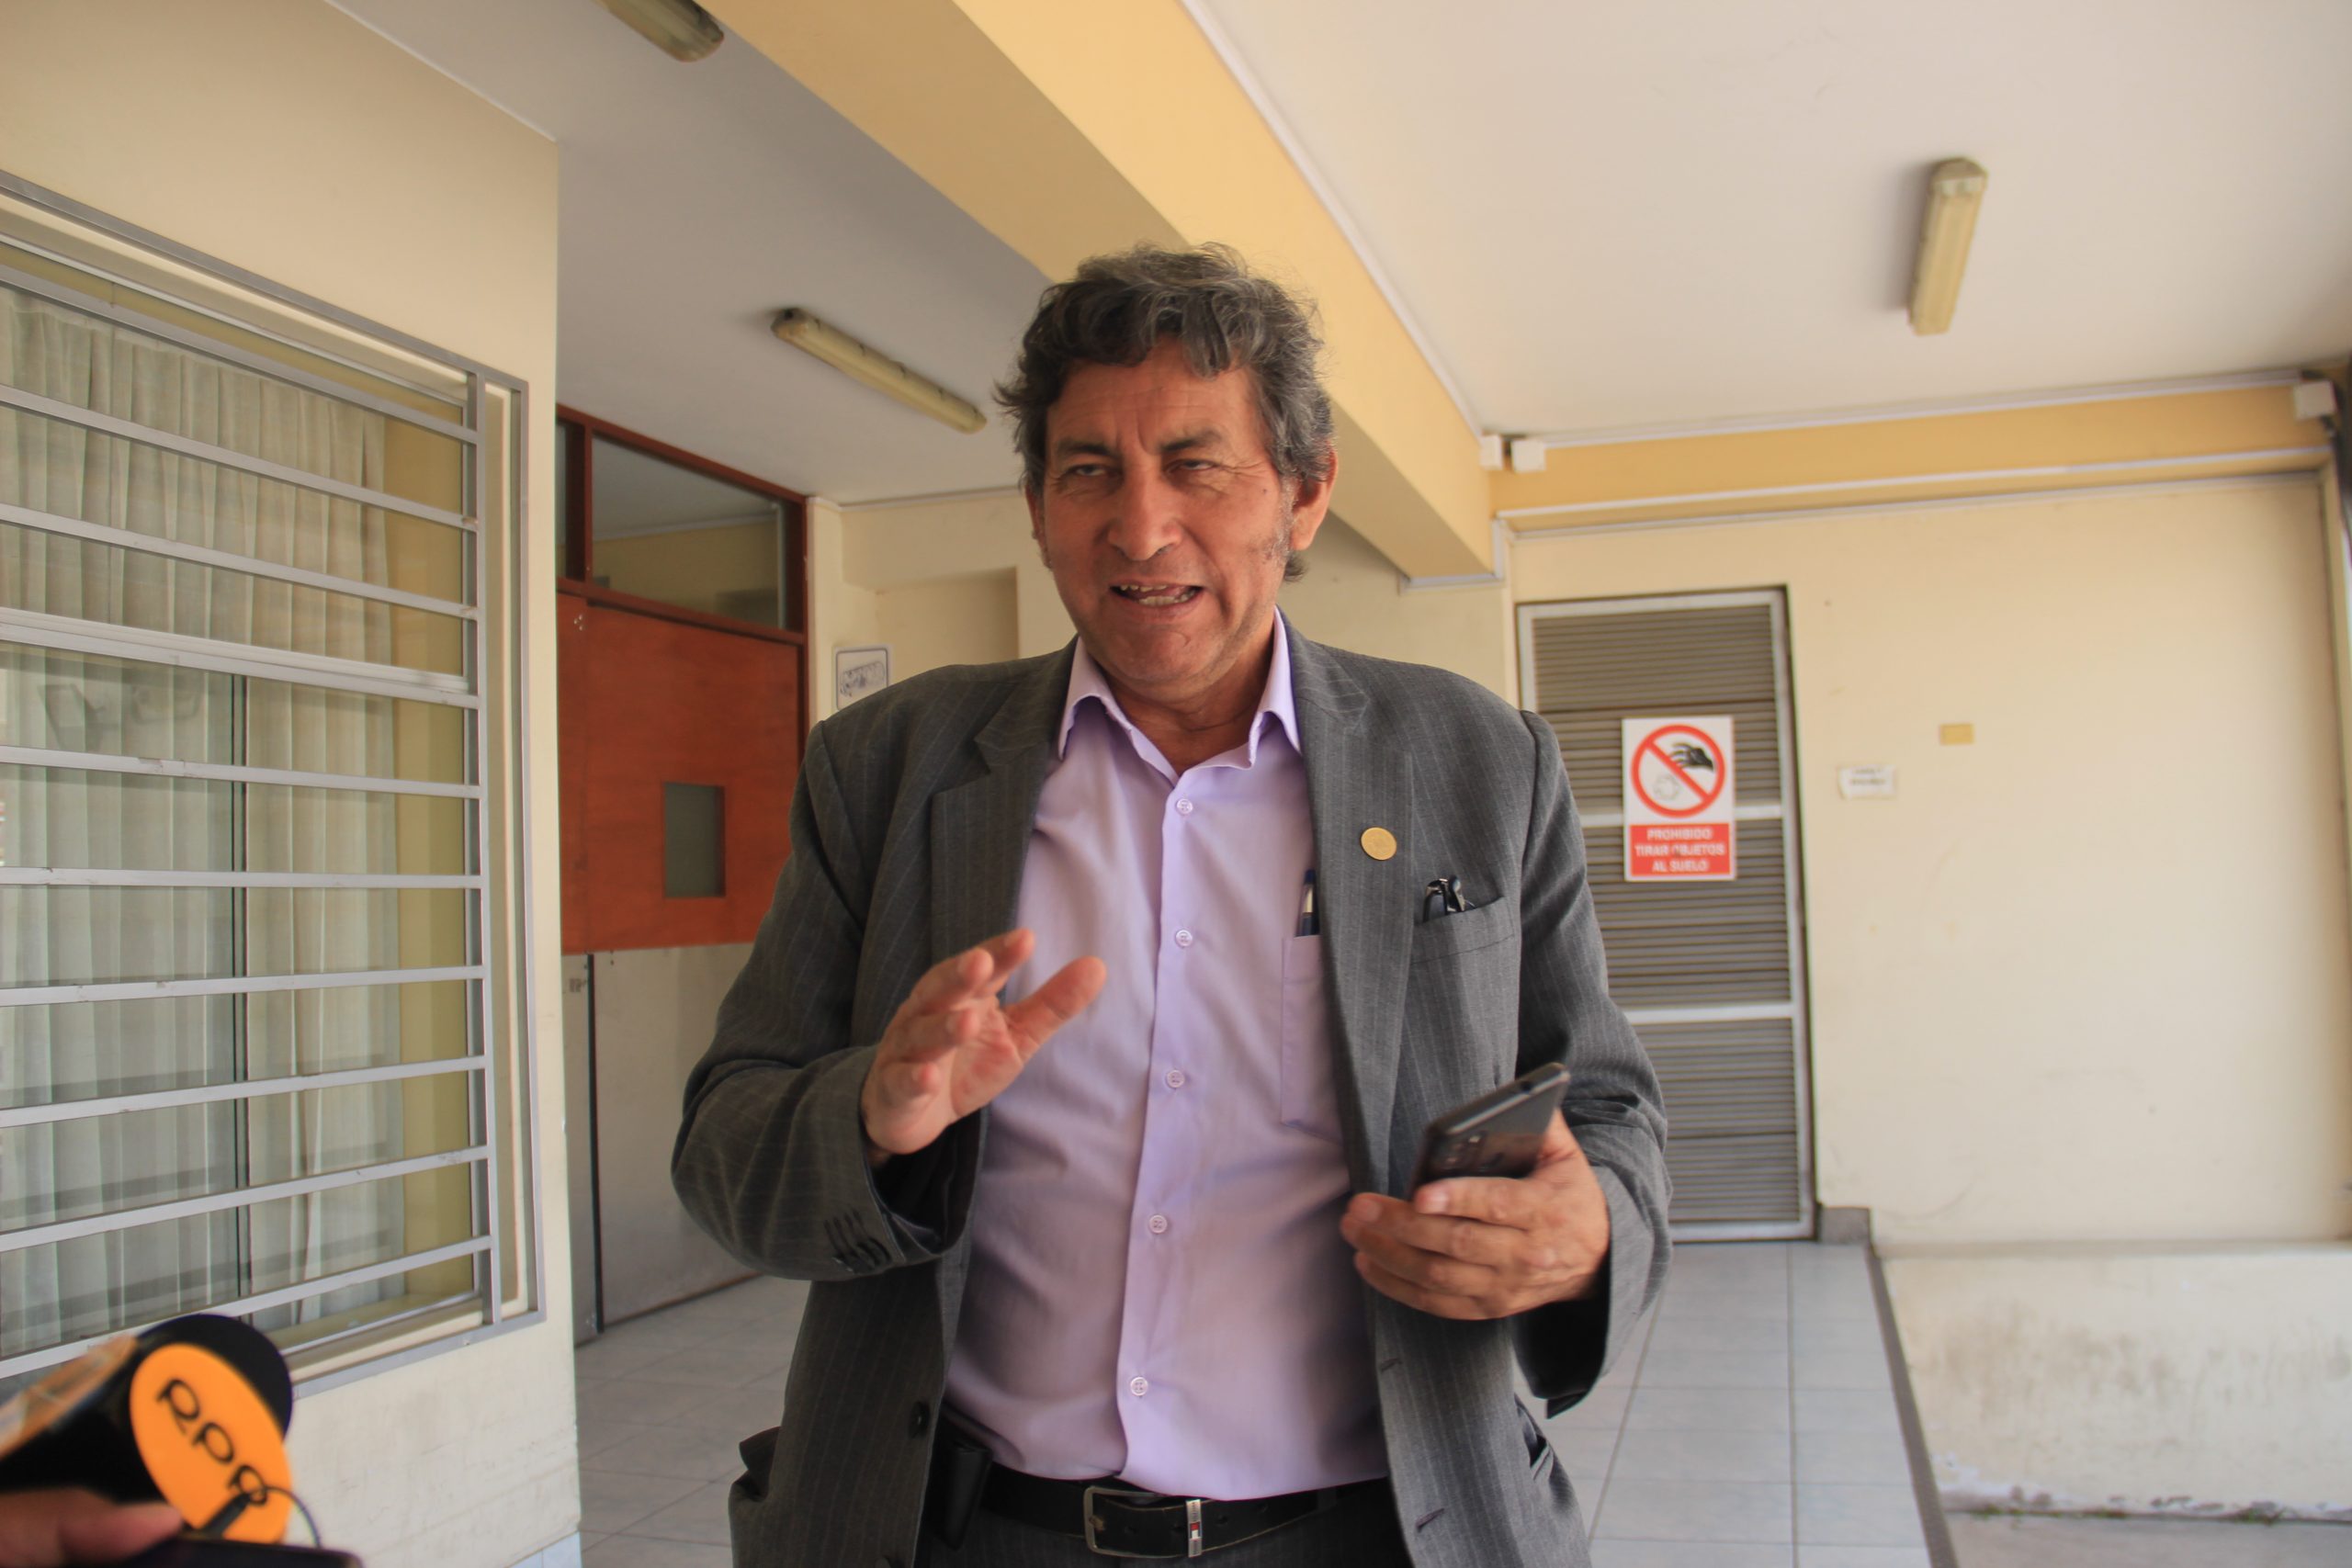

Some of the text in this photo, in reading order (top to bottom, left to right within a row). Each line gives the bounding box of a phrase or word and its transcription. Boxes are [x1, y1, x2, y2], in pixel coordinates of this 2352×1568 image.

[1646, 828, 1713, 840] PROHIBIDO
[1634, 844, 1668, 857] TIRAR
[1652, 859, 1709, 872] AL SUELO
[154, 1378, 268, 1506] RPP
